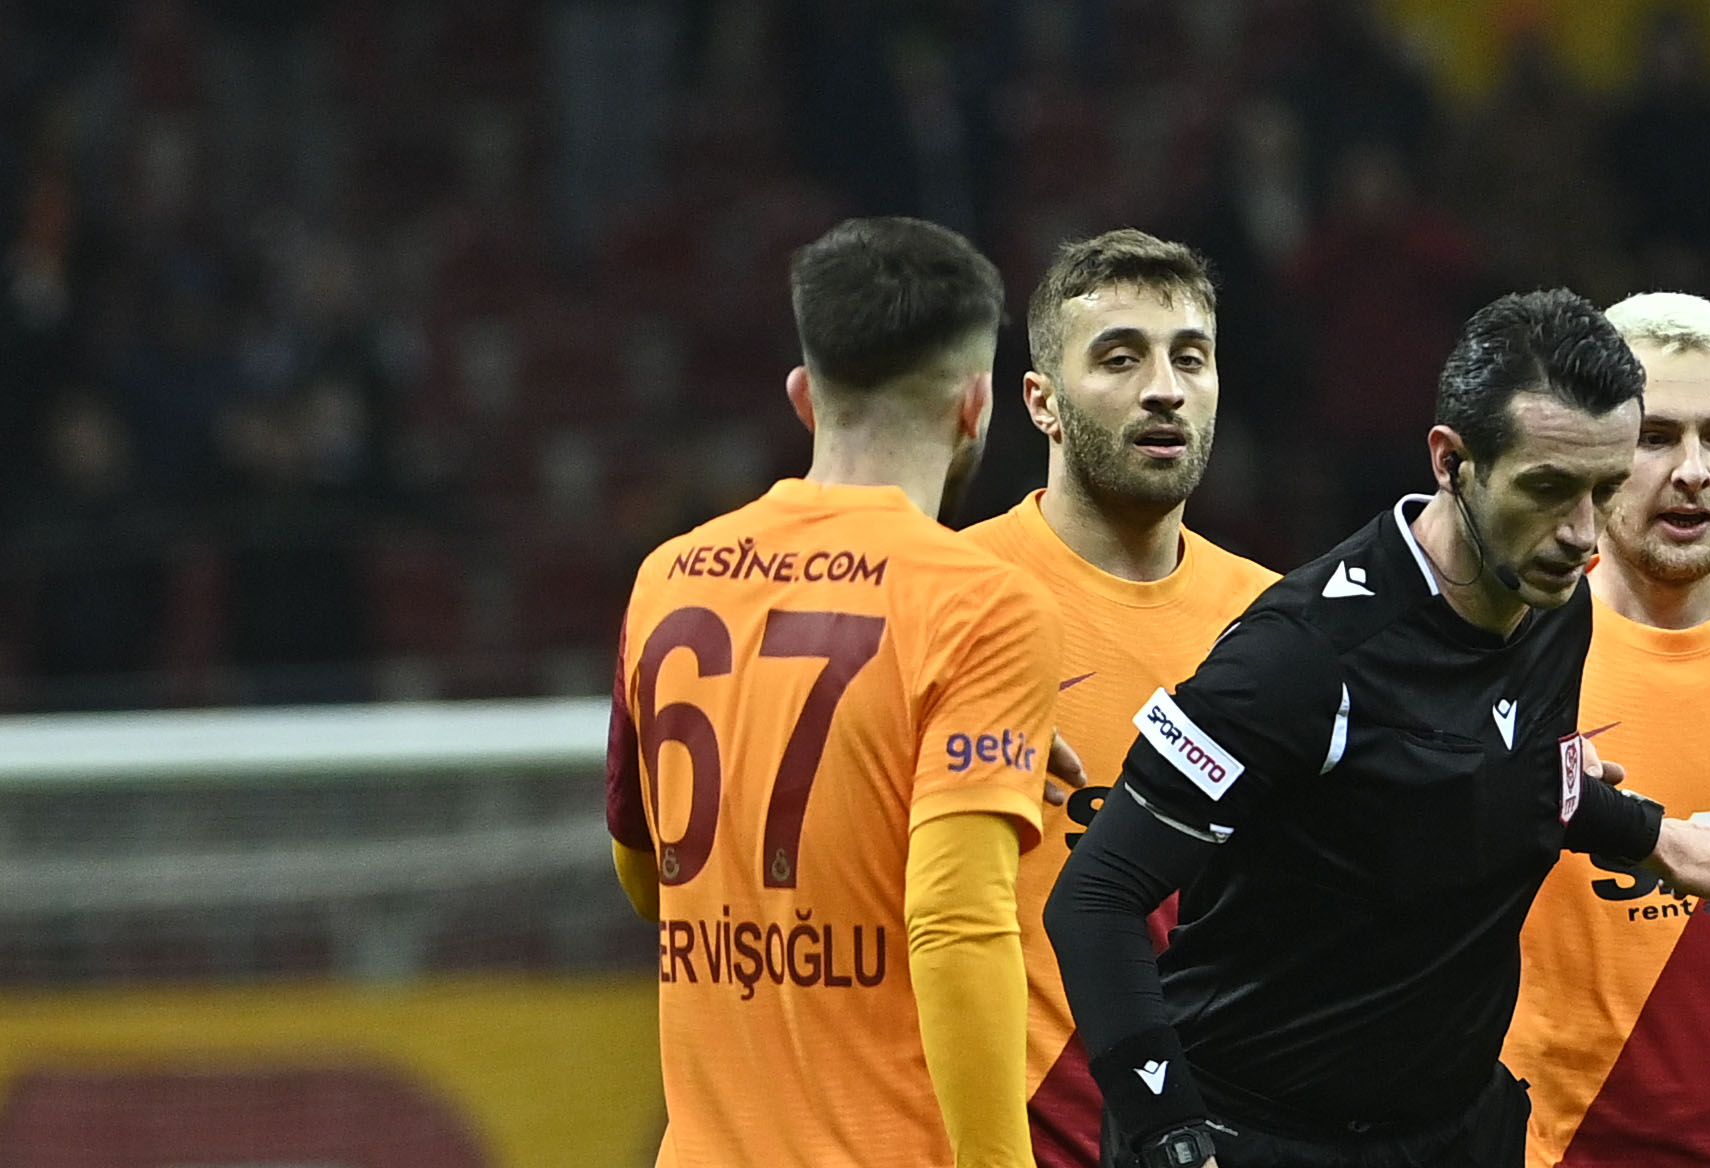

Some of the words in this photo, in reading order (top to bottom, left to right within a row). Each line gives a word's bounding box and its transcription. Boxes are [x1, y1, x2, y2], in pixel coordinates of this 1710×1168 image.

[637, 606, 886, 889] 67
[946, 728, 1036, 772] getir
[1629, 899, 1693, 922] rent
